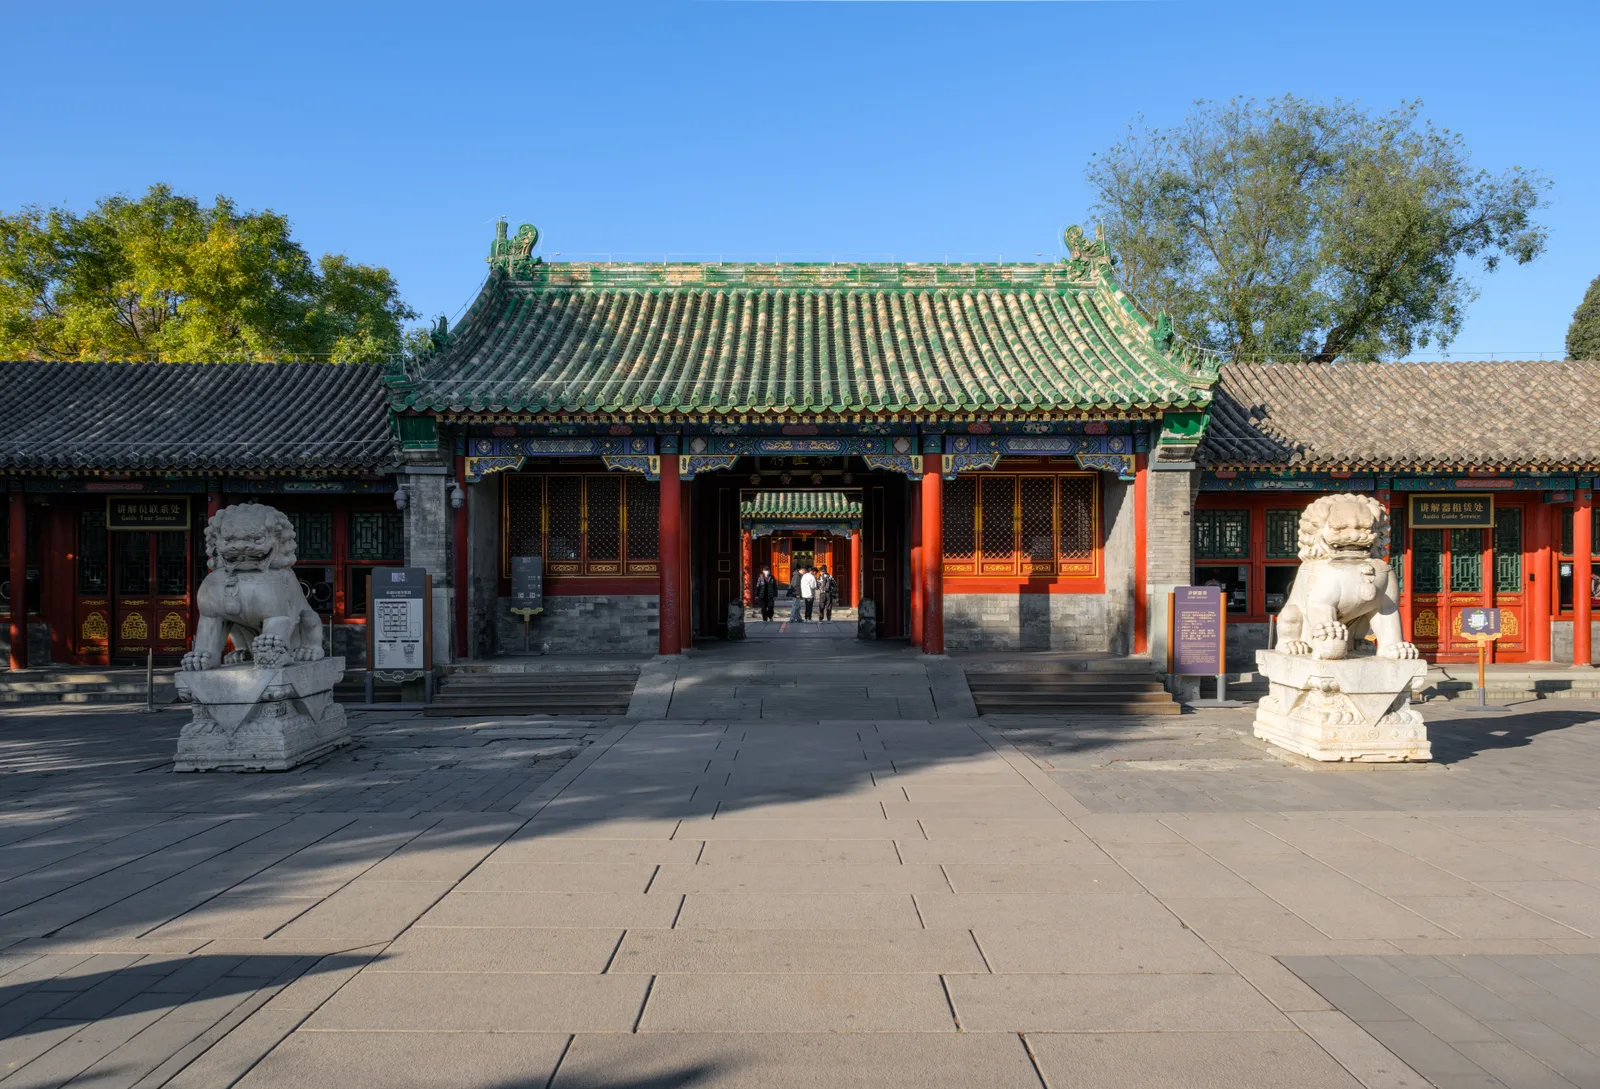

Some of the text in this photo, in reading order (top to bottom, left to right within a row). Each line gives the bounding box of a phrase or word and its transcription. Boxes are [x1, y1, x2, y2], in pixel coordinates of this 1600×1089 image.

[117, 504, 180, 514] 讲解员联系处
[1420, 502, 1483, 512] 讲解器租赁处
